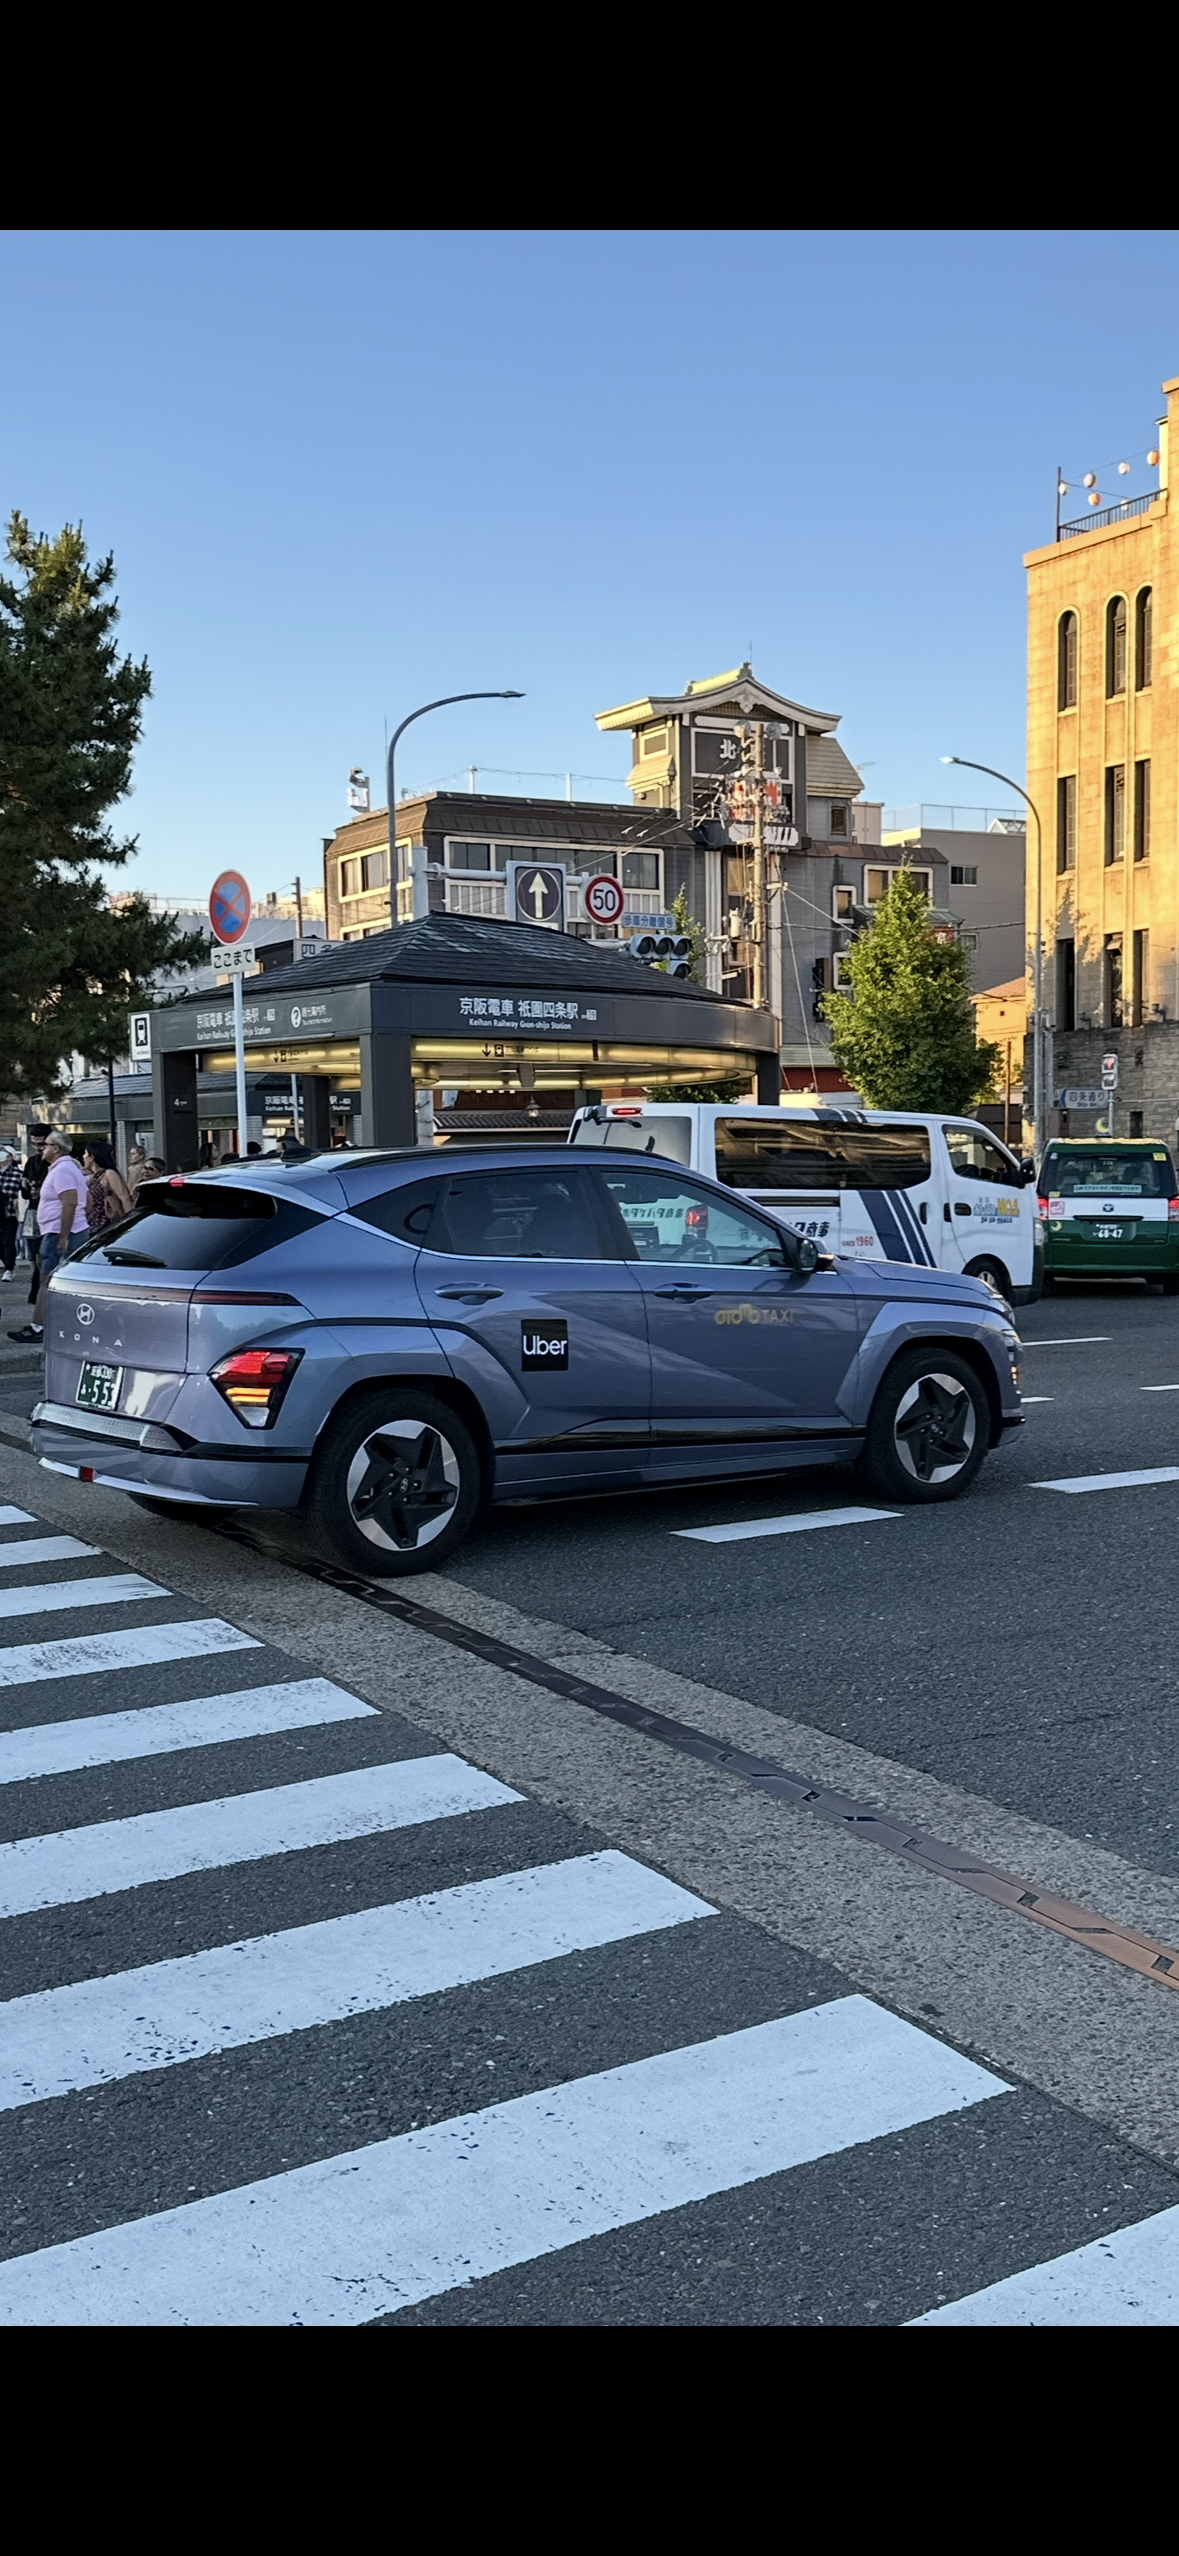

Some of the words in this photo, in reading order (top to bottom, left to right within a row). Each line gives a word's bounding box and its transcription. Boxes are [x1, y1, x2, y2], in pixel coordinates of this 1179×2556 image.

[719, 738, 737, 760] 北
[593, 889, 616, 911] 50
[213, 948, 253, 970] ここまで
[459, 997, 514, 1017] 京阪電車
[518, 1000, 579, 1020] 祇園四条駅
[469, 1018, 493, 1027] Keihan
[494, 1019, 518, 1029] Railway
[551, 1021, 572, 1030] Station
[856, 1236, 874, 1246] 1960
[59, 1330, 123, 1347] KONA
[523, 1335, 568, 1356] Uber
